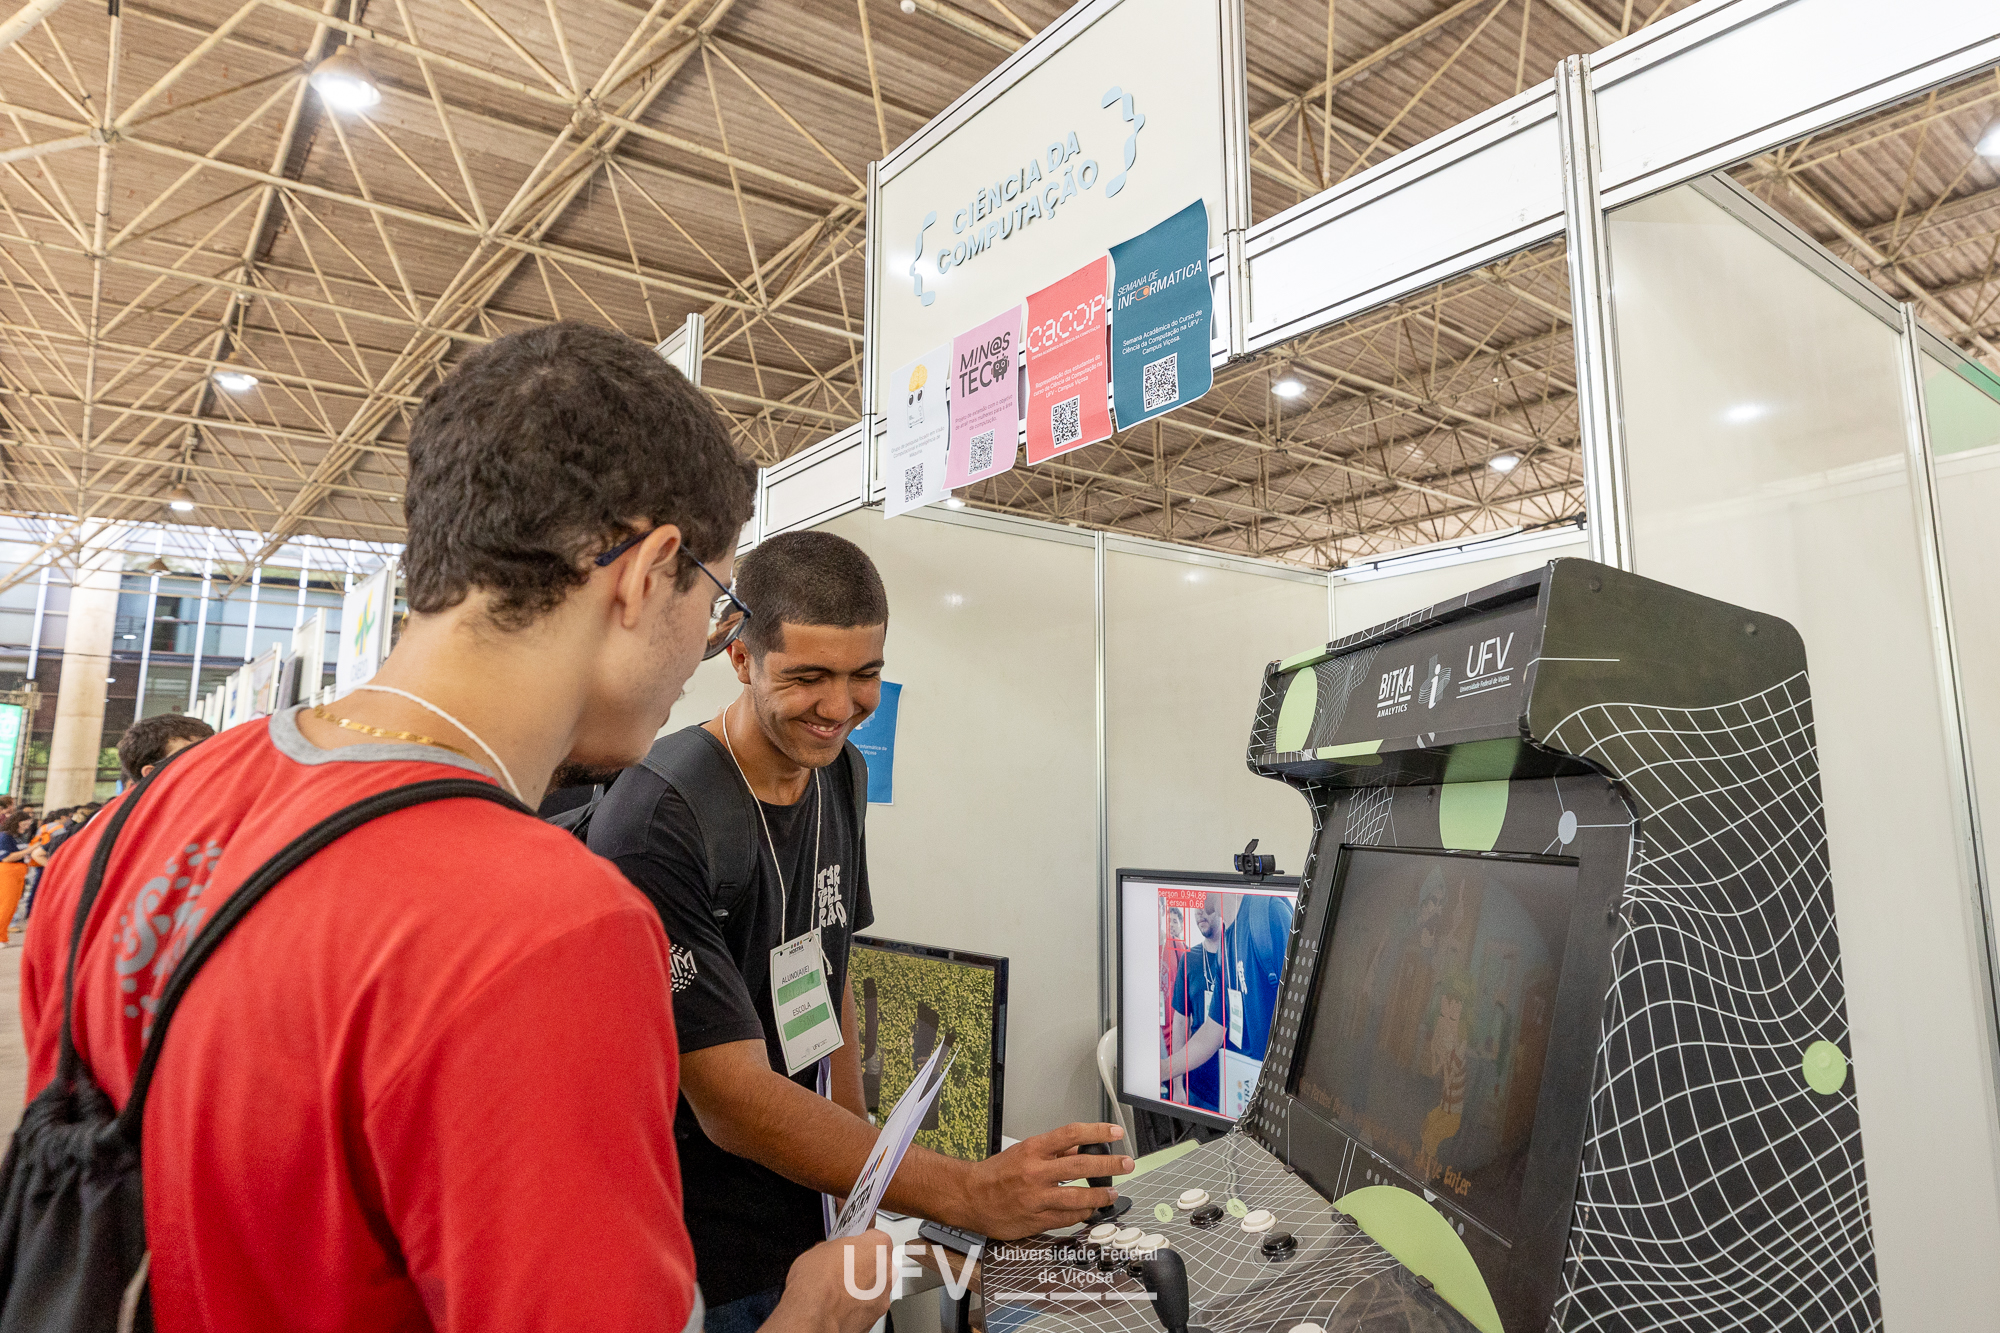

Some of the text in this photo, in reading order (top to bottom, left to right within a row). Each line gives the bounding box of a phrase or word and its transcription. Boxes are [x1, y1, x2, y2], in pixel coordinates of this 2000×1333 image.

[953, 131, 1080, 235] CIÊNCIA DA
[937, 160, 1099, 275] COMPUTAÇÃO
[1117, 269, 1159, 296] SEMANA DE
[1122, 343, 1140, 355] Ciência
[1148, 327, 1179, 345] Computação
[1188, 318, 1200, 328] UFV
[1123, 335, 1142, 347] Semana
[1143, 323, 1170, 339] Acadêmica
[1179, 313, 1194, 323] Curso
[960, 331, 1011, 372] MIN@S
[1142, 343, 1162, 355] Campus
[1033, 388, 1044, 397] curso
[1050, 379, 1064, 389] Ciência
[1071, 364, 1096, 379] Computação
[1035, 372, 1064, 388] Representação
[1072, 357, 1094, 371] estudantes
[1046, 390, 1054, 398] UFV
[1058, 382, 1074, 393] Campus
[1466, 632, 1514, 678] UFV
[1378, 665, 1414, 703] BITKA
[1377, 704, 1408, 718] ANALYTICS
[1189, 900, 1204, 908] 0.66
[792, 1002, 811, 1016] ESCOLA
[1444, 1165, 1472, 1196] Enter
